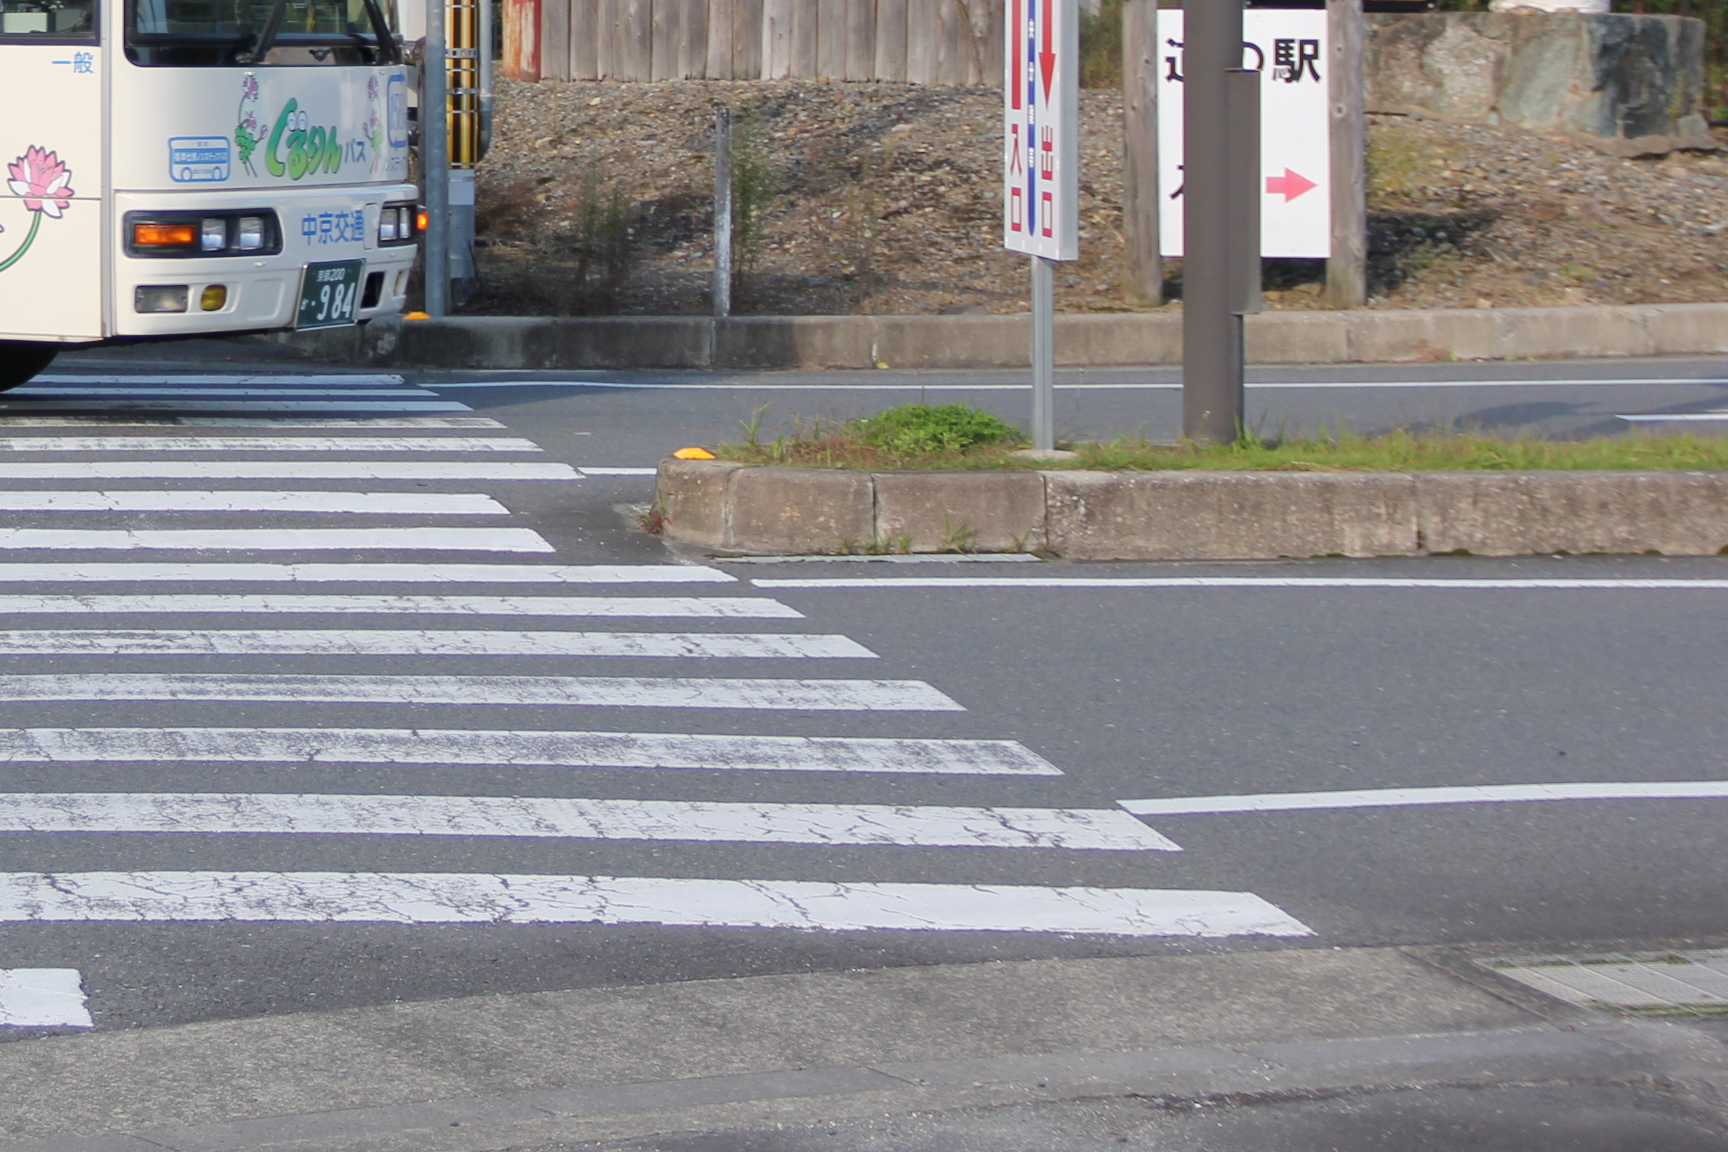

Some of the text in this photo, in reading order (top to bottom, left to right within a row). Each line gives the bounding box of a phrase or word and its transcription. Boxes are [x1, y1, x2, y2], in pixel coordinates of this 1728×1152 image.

[51, 51, 94, 74] 一般
[1010, 123, 1023, 233] 入口
[1041, 125, 1053, 238] 出口
[302, 211, 364, 246] 中京交通
